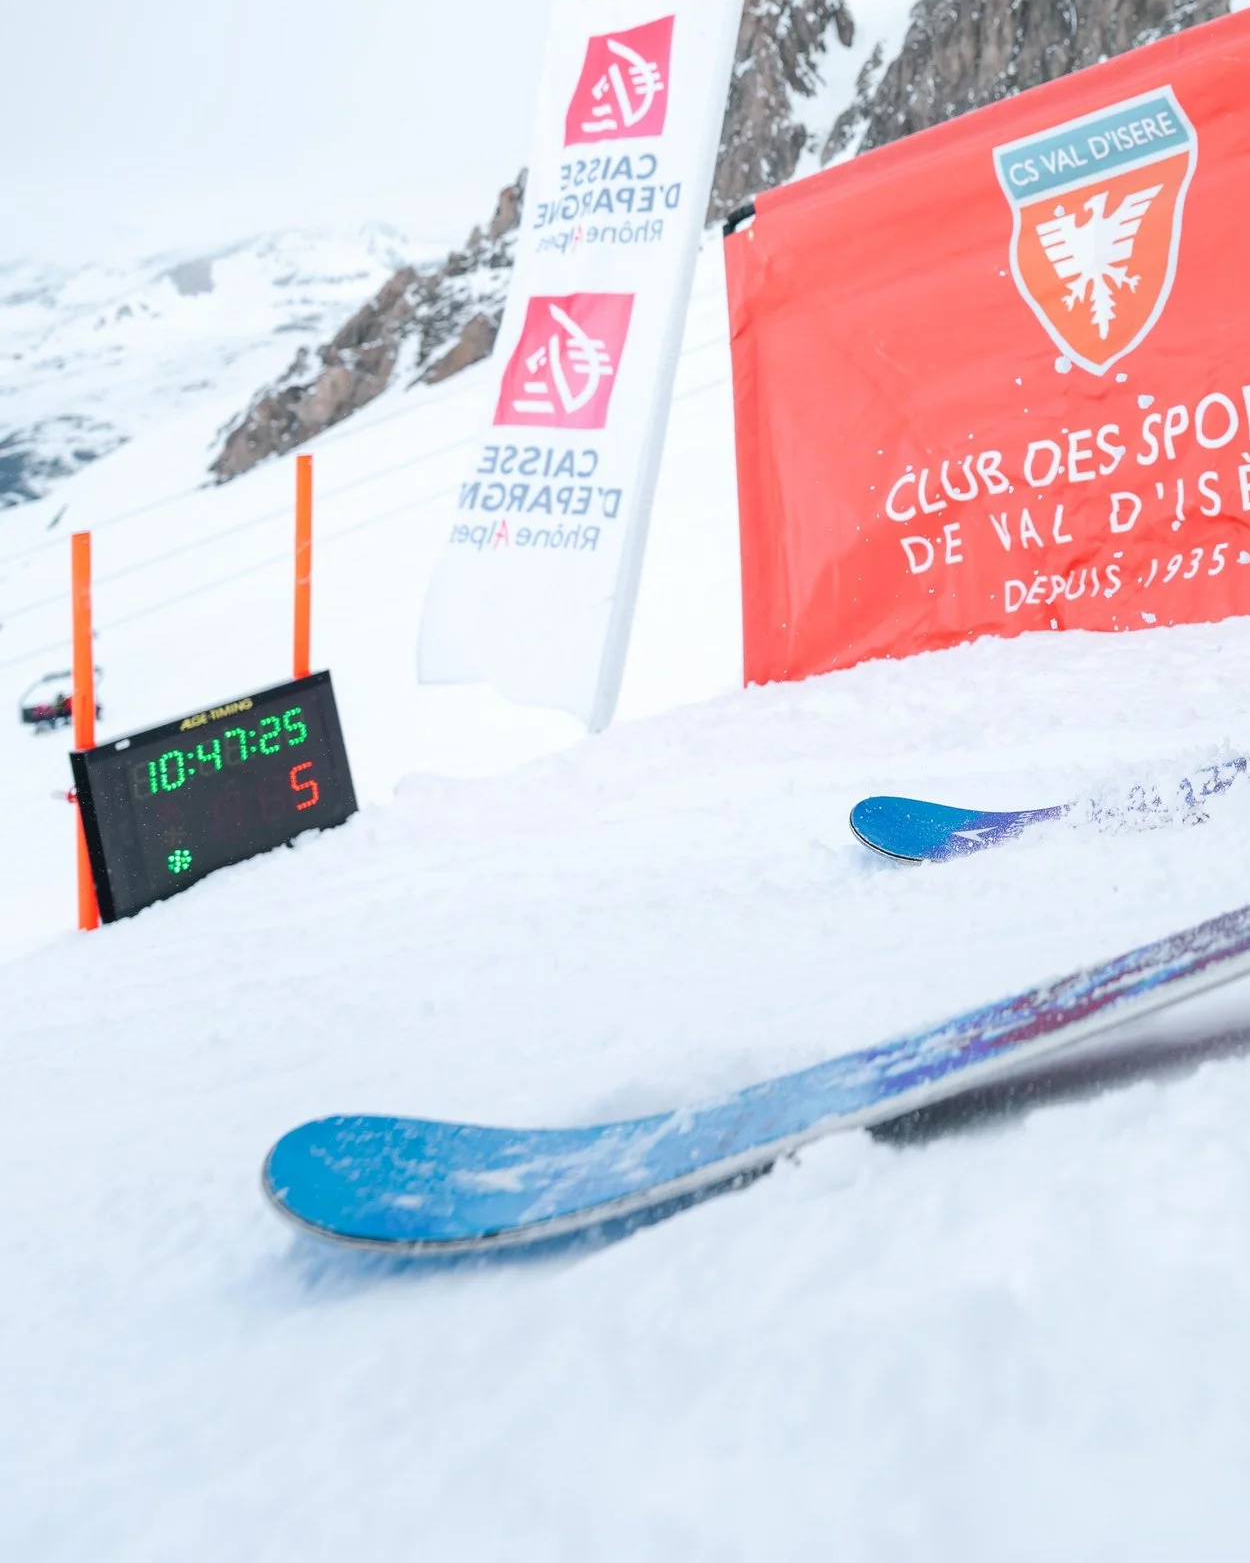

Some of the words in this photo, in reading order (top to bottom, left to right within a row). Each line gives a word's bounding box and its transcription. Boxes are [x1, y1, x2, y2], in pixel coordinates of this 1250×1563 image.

[1009, 159, 1040, 186] CS
[1039, 144, 1088, 174] VAL
[1088, 111, 1177, 160] D'ISERE
[886, 449, 1011, 523] CLUB
[1024, 424, 1127, 489] DES
[901, 523, 964, 574] DE
[990, 503, 1073, 553] VAL
[1005, 564, 1122, 614] DEPUIS
[148, 706, 308, 794] 10:47:25
